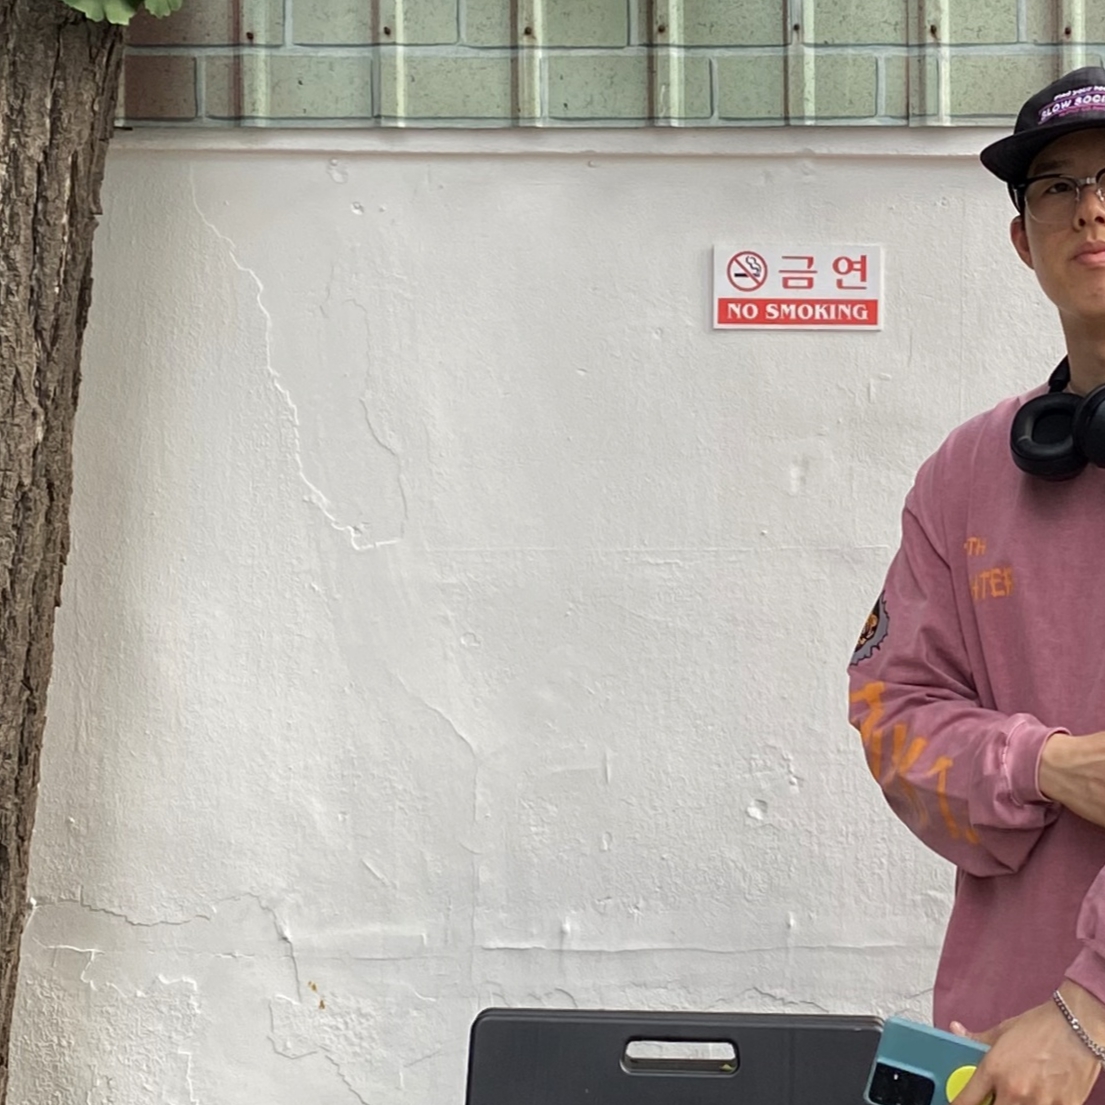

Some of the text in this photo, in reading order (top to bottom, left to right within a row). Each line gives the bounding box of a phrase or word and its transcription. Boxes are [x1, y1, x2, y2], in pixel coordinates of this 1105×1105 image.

[1041, 99, 1072, 118] SLOW
[727, 302, 869, 321] NO SMOKING
